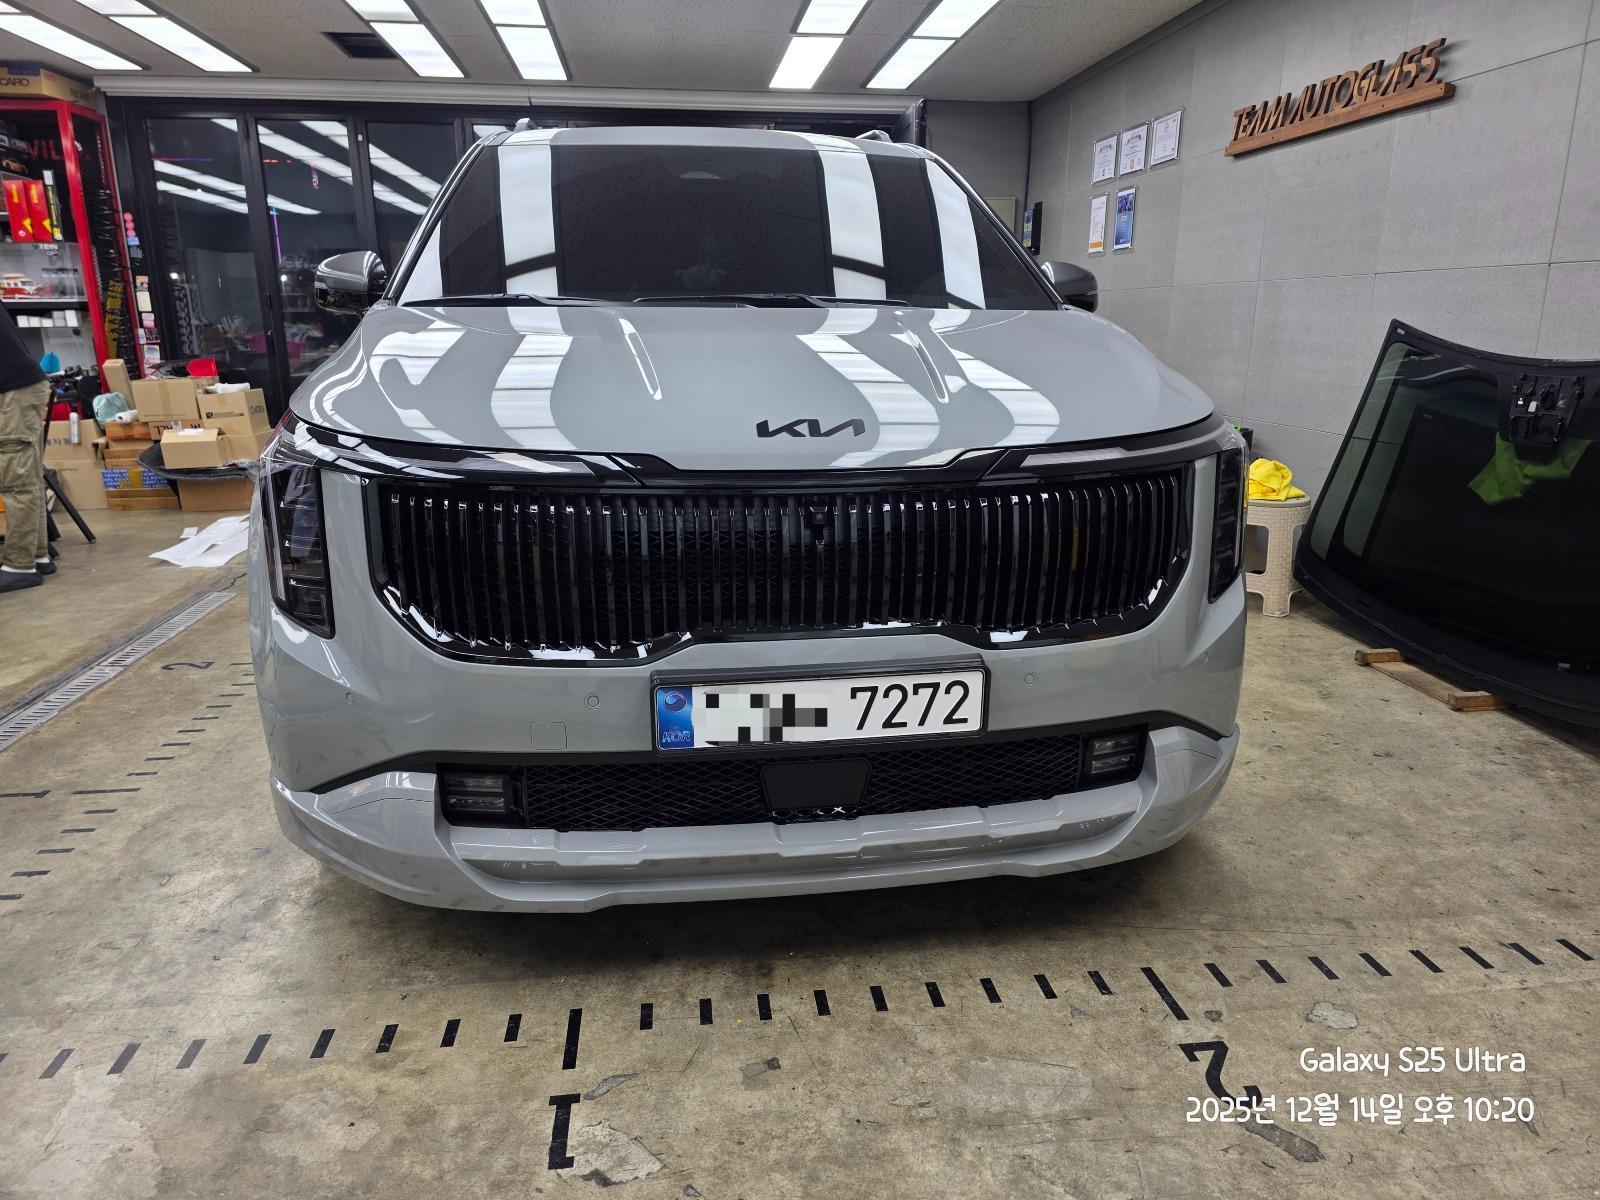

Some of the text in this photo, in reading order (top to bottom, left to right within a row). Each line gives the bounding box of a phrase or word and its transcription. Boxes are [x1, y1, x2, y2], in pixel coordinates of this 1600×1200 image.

[1234, 38, 1446, 141] TEAM AUTOGLASS
[756, 418, 866, 438] KIA
[850, 679, 970, 731] 7272
[662, 730, 691, 743] KOR
